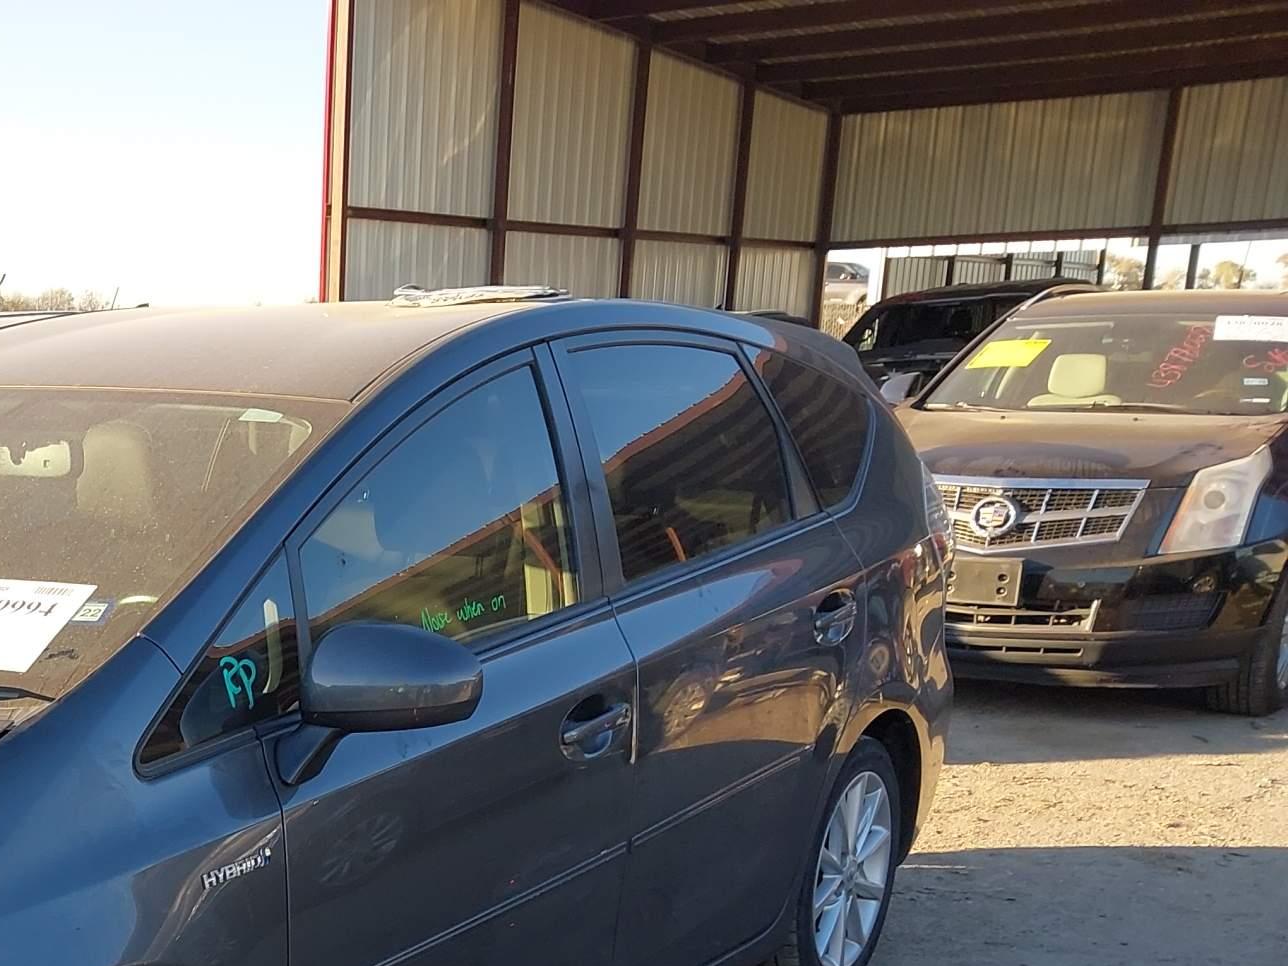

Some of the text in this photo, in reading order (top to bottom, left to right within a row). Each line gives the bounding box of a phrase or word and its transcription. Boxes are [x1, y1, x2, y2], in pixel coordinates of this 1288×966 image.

[491, 594, 506, 612] on
[79, 608, 102, 618] 22
[200, 854, 262, 890] HYBRID
